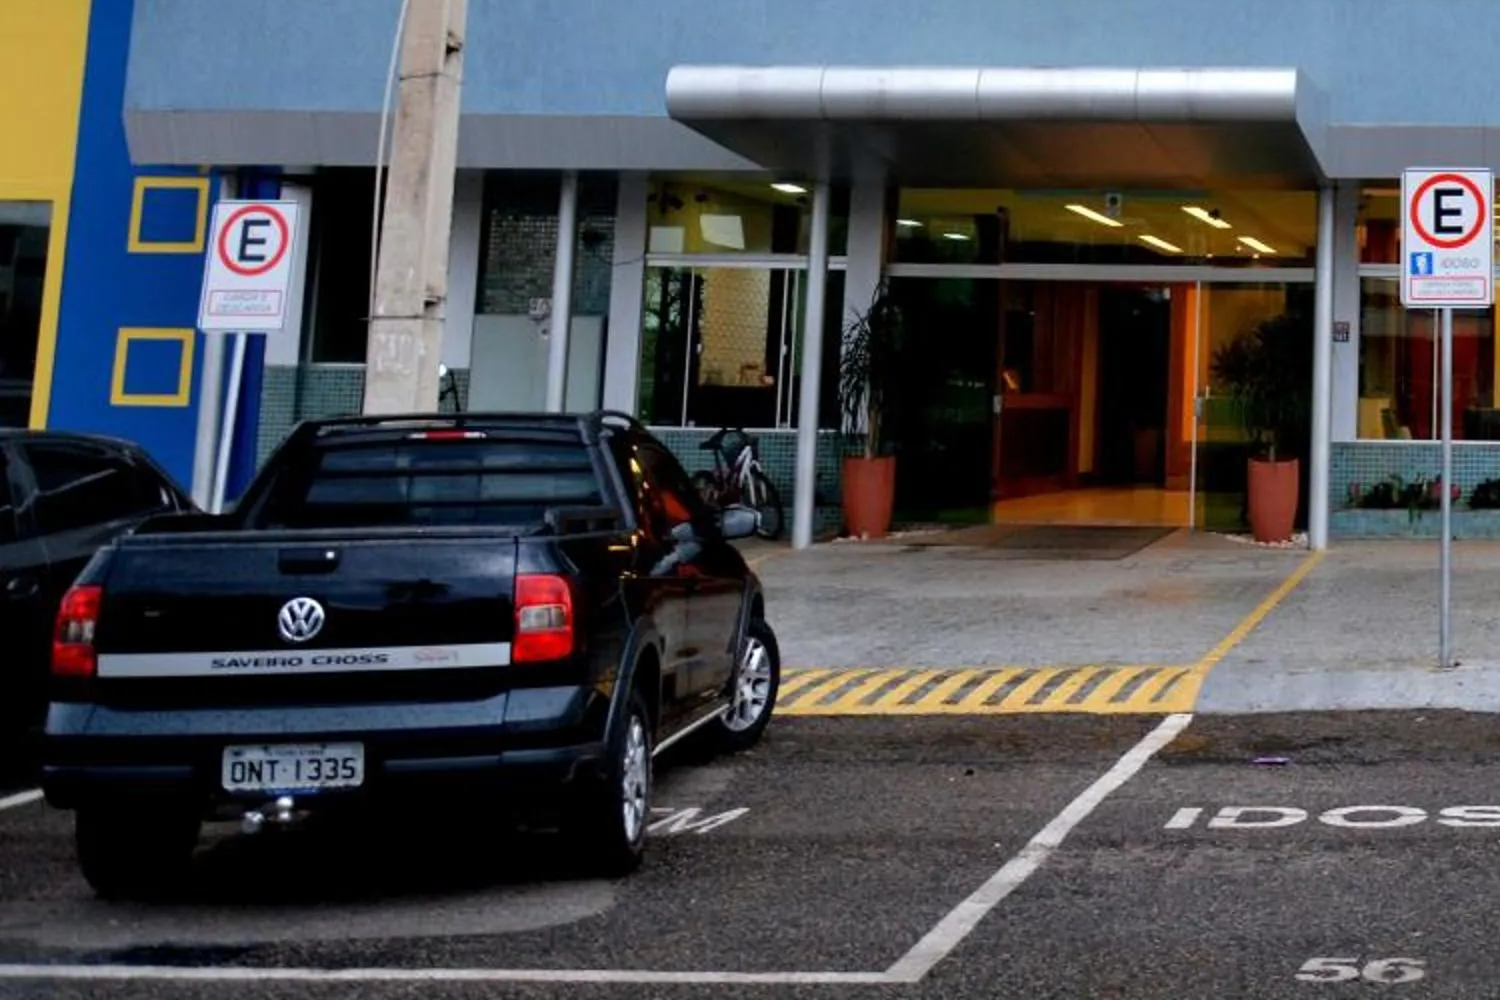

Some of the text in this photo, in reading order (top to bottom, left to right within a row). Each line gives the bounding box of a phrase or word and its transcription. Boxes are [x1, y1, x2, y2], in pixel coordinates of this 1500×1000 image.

[1434, 188, 1464, 234] E
[238, 219, 271, 262] E
[211, 653, 389, 669] SAVEIRO CROSS
[1296, 956, 1426, 984] 56
